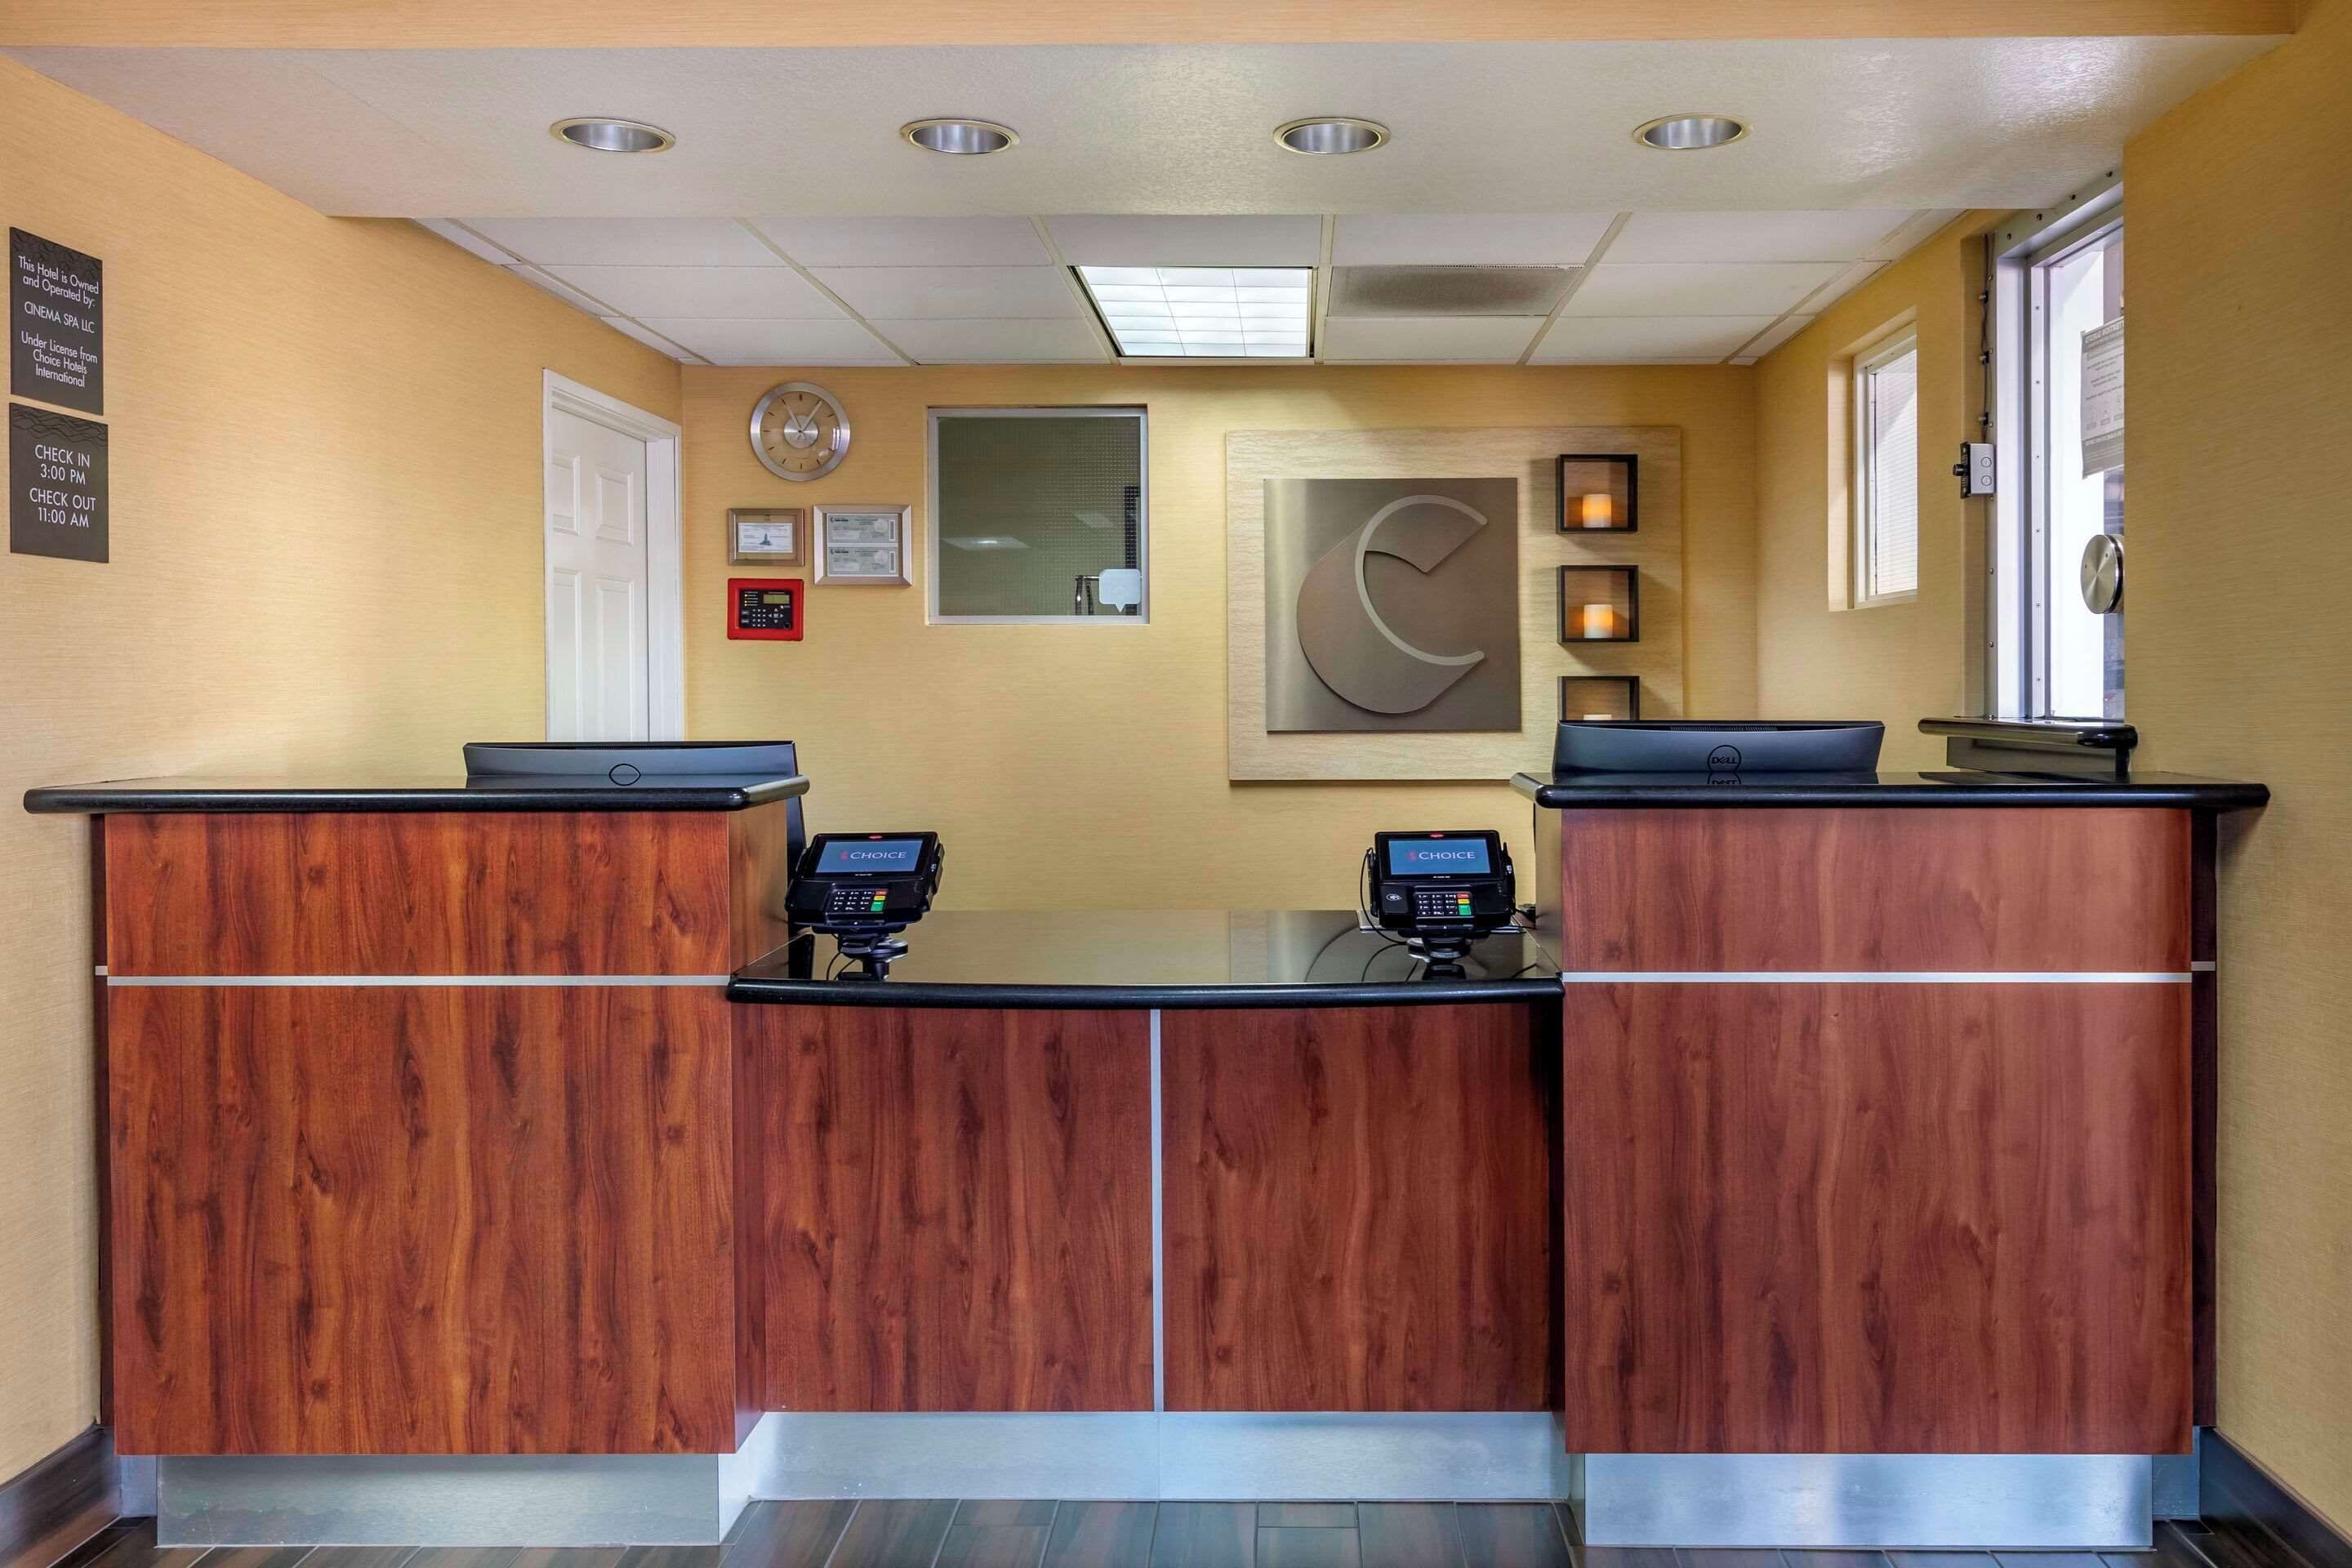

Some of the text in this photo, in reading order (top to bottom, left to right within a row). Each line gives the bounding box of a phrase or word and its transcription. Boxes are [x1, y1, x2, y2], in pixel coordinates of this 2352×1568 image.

[19, 256, 99, 294] This Hotel is Owned
[23, 275, 96, 309] and Operated by:
[24, 301, 95, 333] CINEMA SPA LLC
[21, 331, 97, 363] Under License from
[33, 350, 87, 374] Choice Hotels
[36, 364, 85, 388] International
[35, 444, 90, 468] CHECK IN
[40, 464, 86, 485] 3:00 PM
[29, 488, 96, 511] CHECK OUT
[38, 507, 89, 528] 11:00 AM
[1419, 852, 1476, 860] CHOICE
